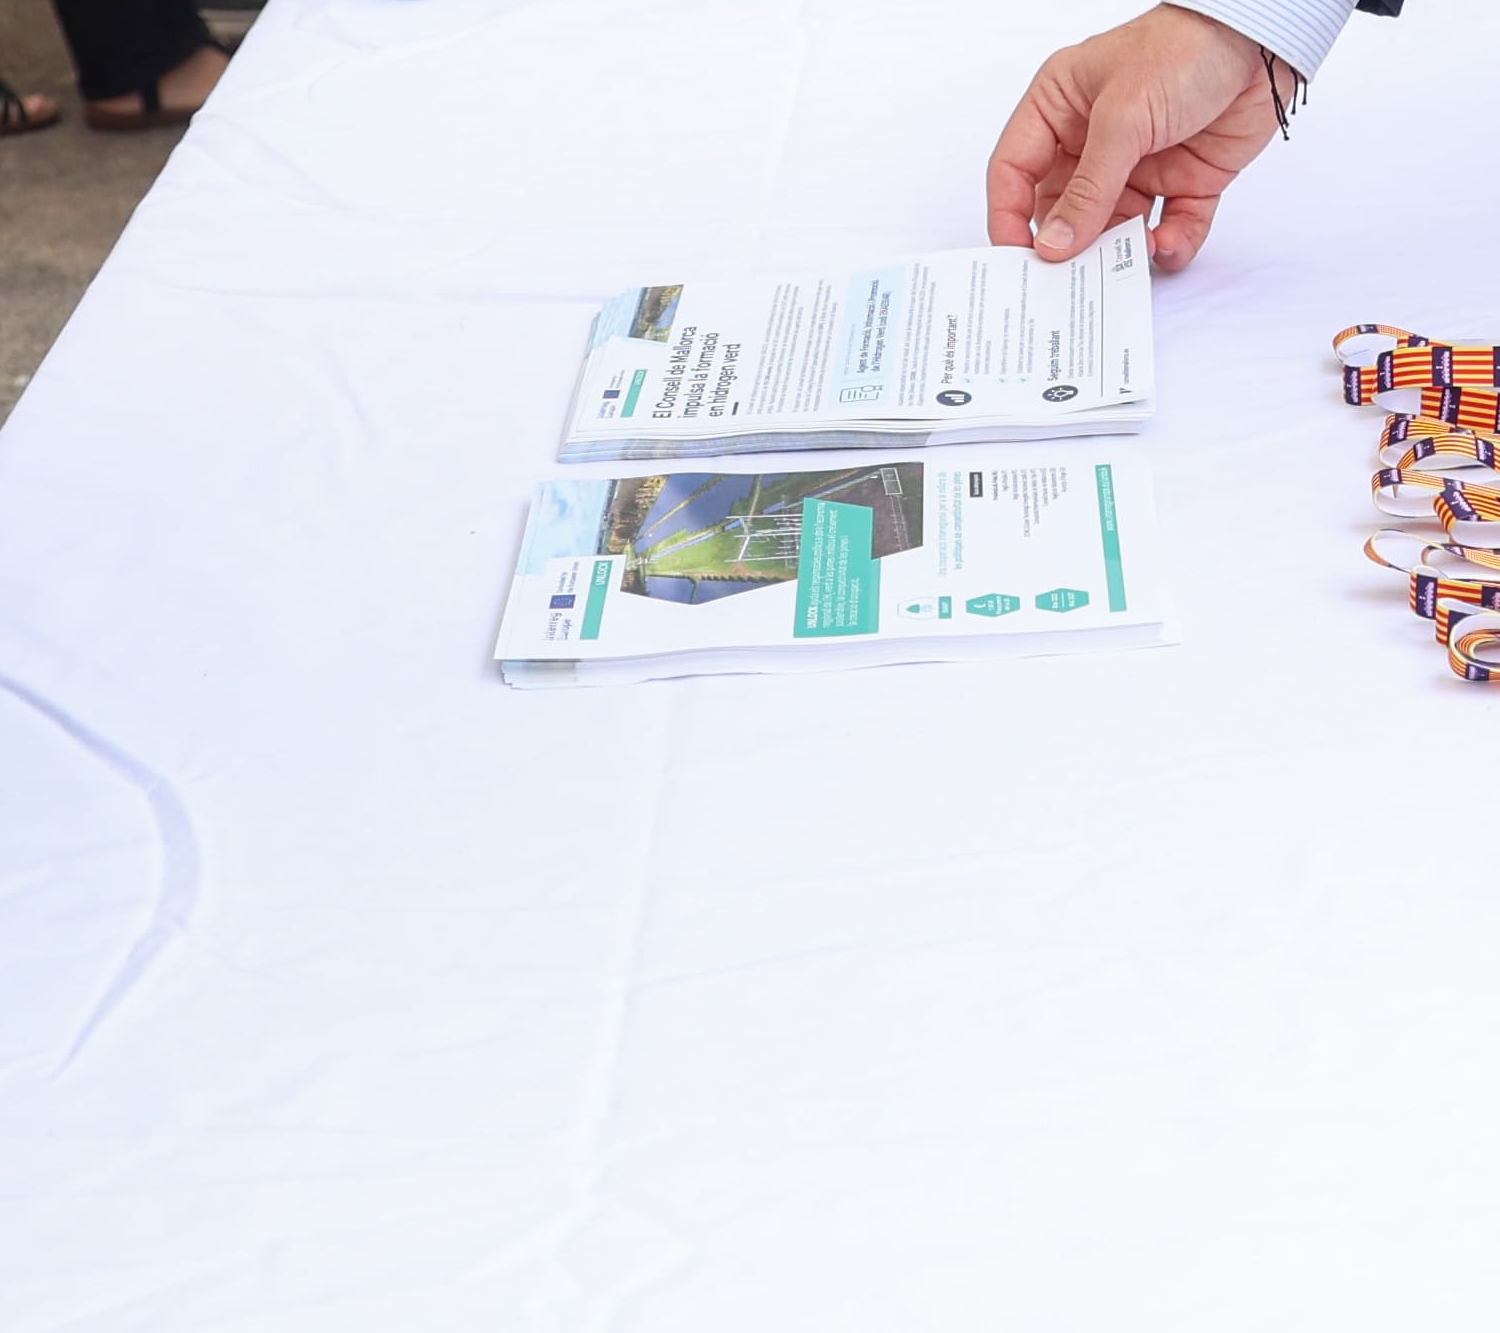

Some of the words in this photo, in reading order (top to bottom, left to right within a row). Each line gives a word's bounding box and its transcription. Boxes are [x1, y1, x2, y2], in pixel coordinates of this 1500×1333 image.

[943, 314, 959, 349] important?
[669, 326, 697, 363] Mallorca
[690, 332, 719, 371] formació
[720, 343, 741, 363] verd
[665, 364, 685, 375] de
[941, 359, 955, 371] què
[1047, 359, 1062, 381] Seguim
[687, 373, 709, 381] la
[707, 365, 738, 404] hidrogen
[941, 372, 952, 384] Per
[655, 376, 683, 409] Consell
[677, 383, 705, 419] impulsa
[651, 410, 672, 419] El
[708, 406, 724, 417] en
[595, 562, 609, 585] UNLOCK
